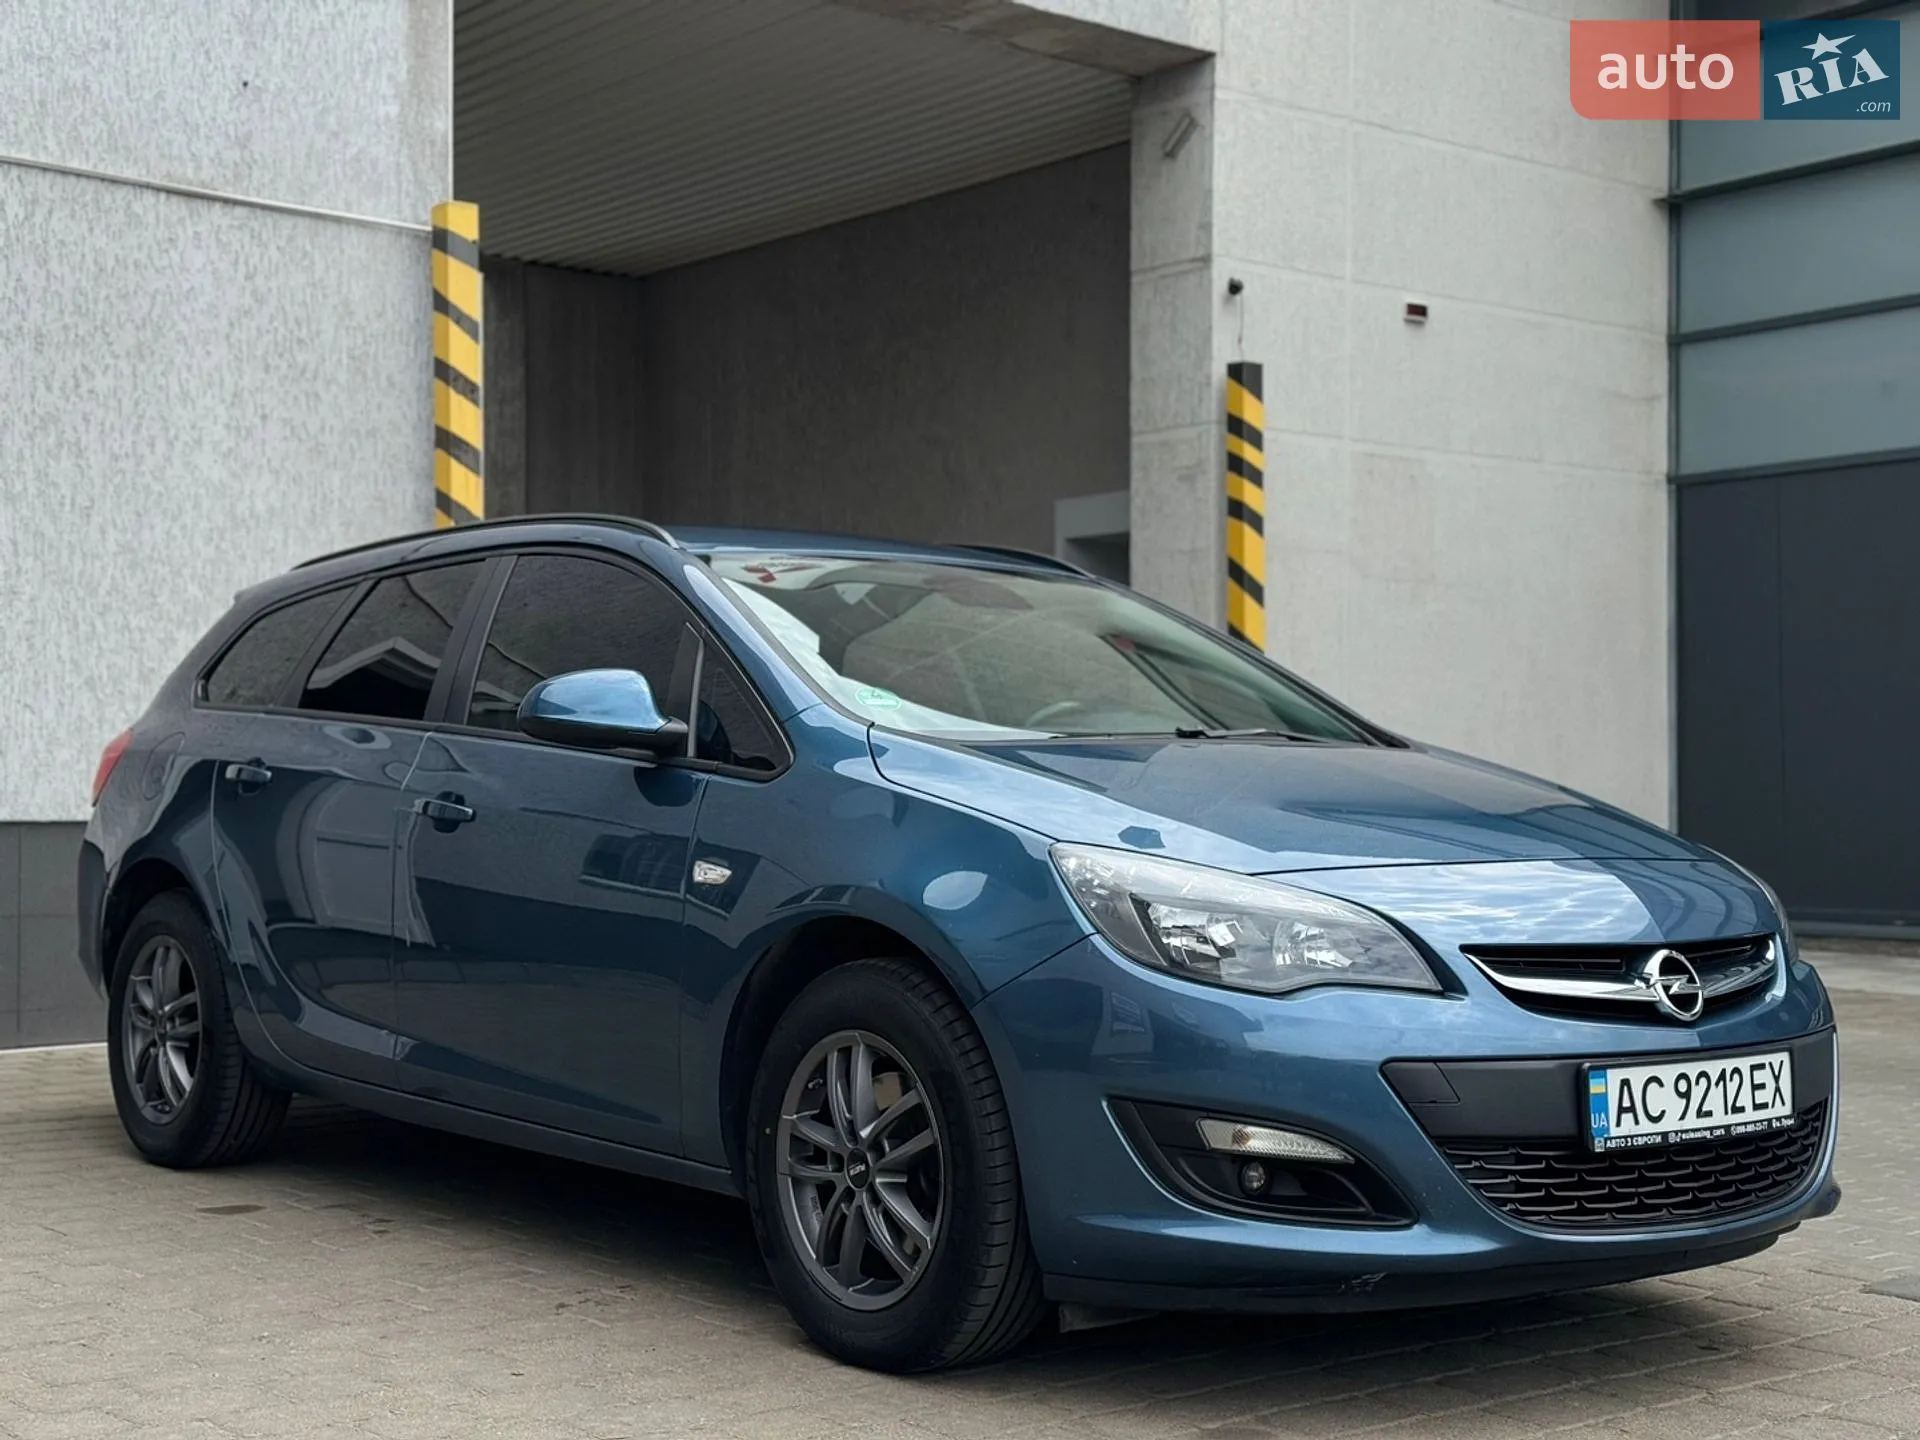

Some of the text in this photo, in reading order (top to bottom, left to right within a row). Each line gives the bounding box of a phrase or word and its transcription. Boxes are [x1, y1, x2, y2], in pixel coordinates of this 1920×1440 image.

[1615, 1060, 1786, 1128] AC 9212 EX
[1591, 1112, 1608, 1129] UA
